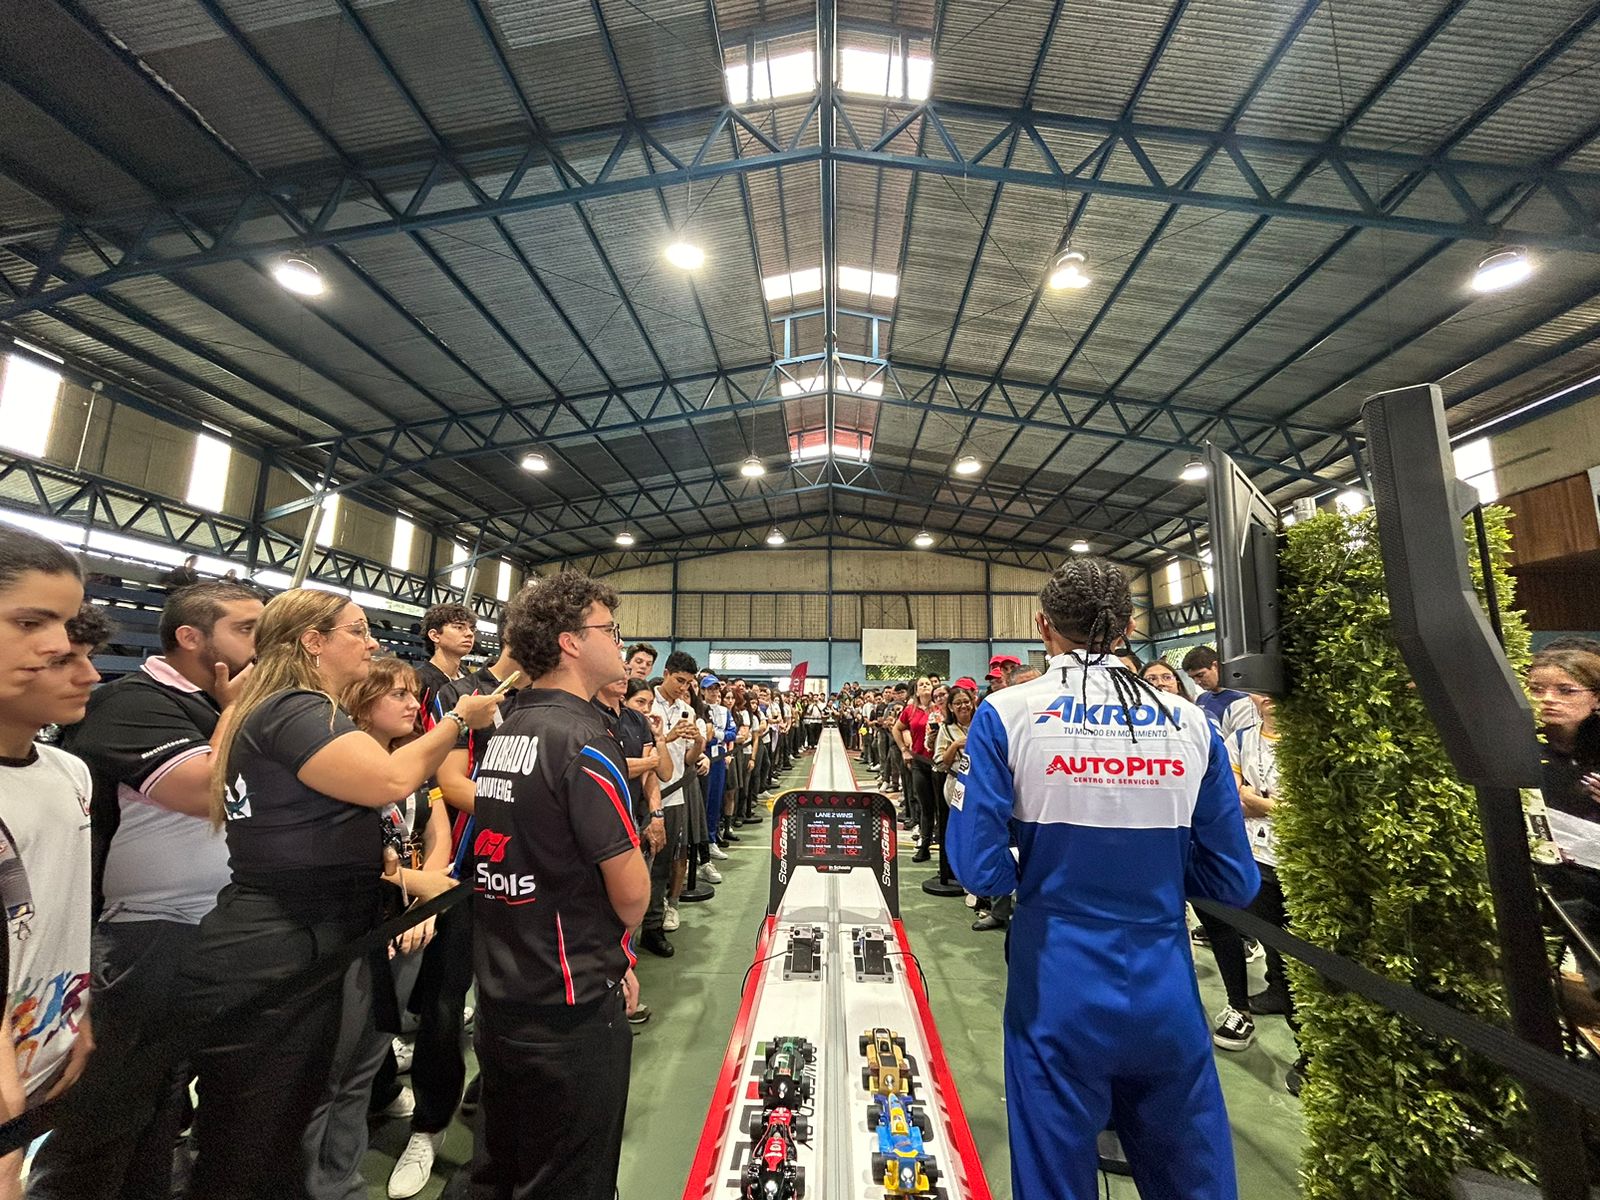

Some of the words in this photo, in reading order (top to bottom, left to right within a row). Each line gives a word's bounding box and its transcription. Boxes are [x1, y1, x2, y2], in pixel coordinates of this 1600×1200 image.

[1033, 695, 1182, 727] AKRON
[1063, 726, 1074, 735] TU
[1106, 729, 1116, 737] EN
[1117, 729, 1168, 738] MOIMIENTO
[480, 735, 539, 776] LVARADO
[1073, 776, 1103, 785] CENTRO
[1118, 778, 1160, 786] SERVICIOS
[778, 818, 788, 885] StartGate
[881, 819, 891, 887] StartGate
